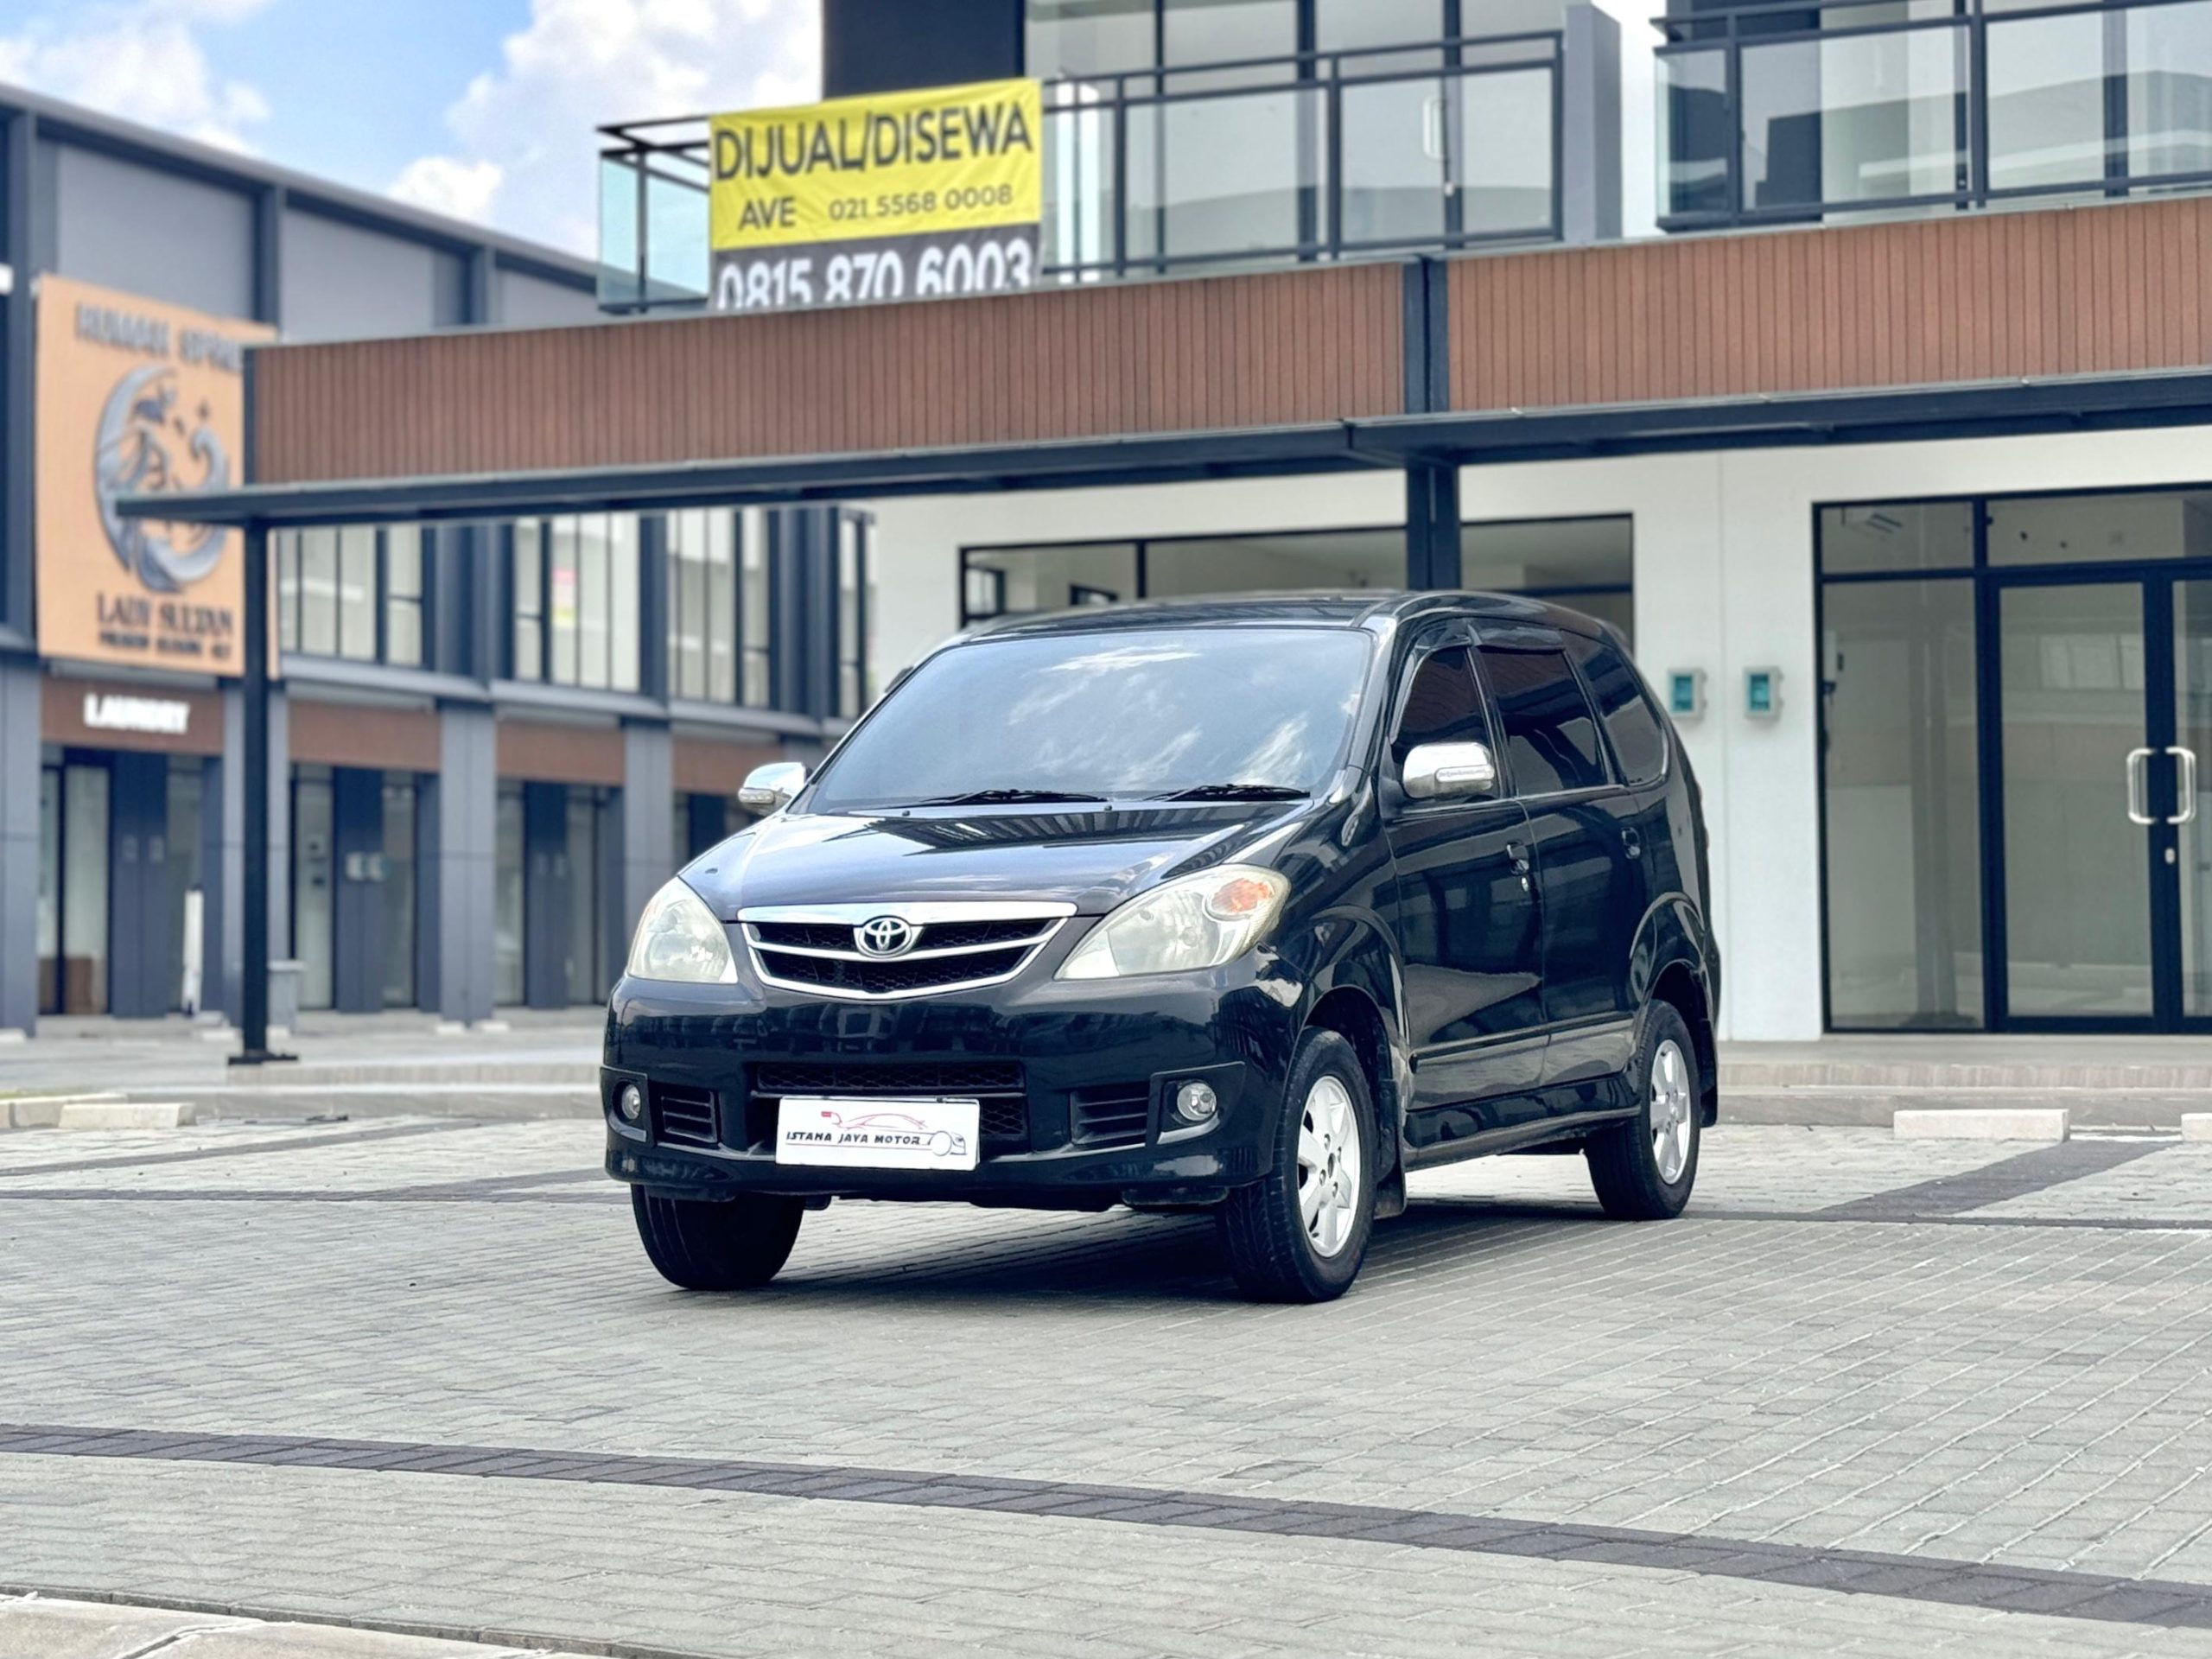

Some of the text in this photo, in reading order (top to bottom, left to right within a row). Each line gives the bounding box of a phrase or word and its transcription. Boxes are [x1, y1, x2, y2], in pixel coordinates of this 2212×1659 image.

[715, 101, 1033, 181] DIJUAL/DISEWA
[739, 196, 796, 230] AVE
[944, 184, 1013, 211] 0008
[718, 262, 812, 310] 0815
[826, 251, 904, 302] 870
[786, 1131, 920, 1145] ISTANA JAYA MOTOR
